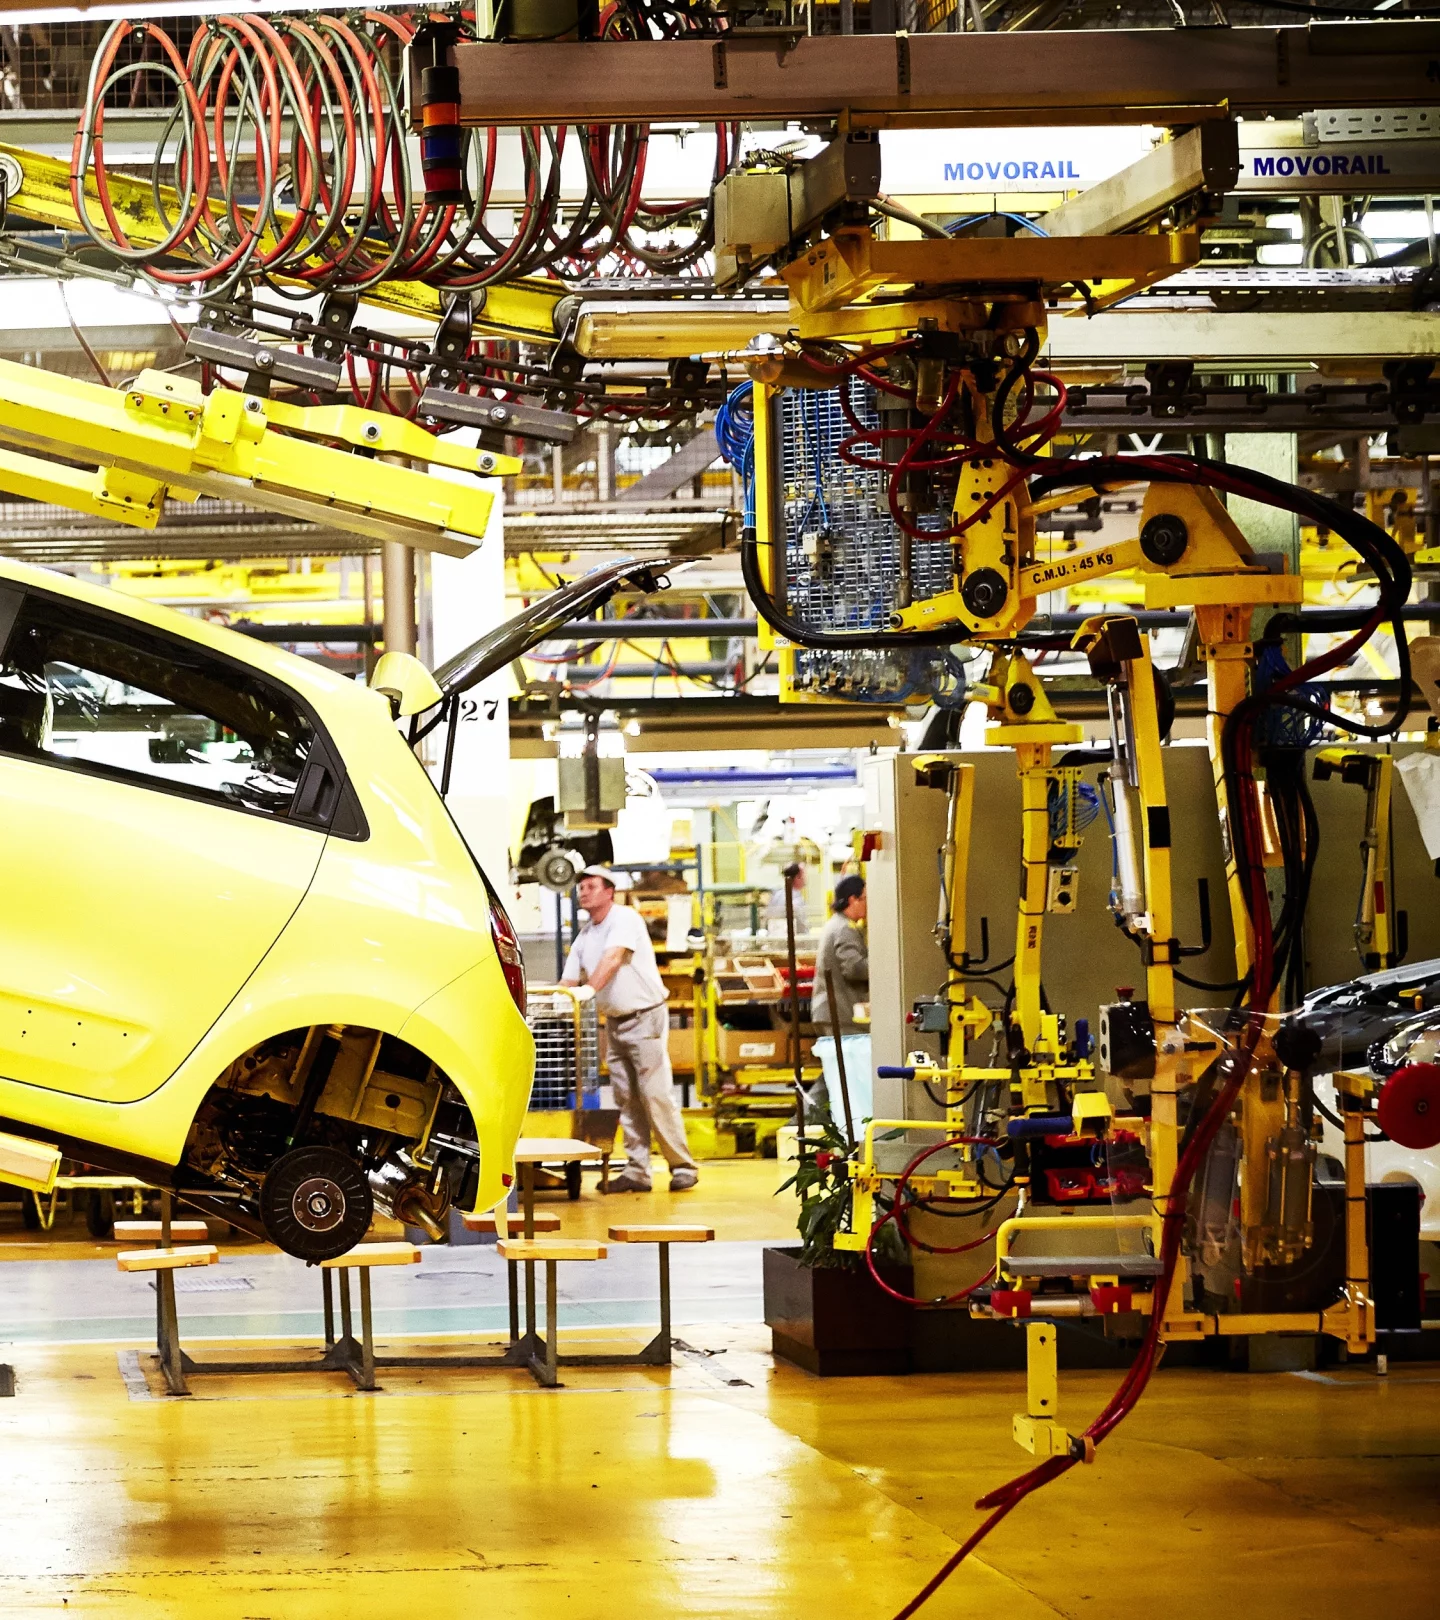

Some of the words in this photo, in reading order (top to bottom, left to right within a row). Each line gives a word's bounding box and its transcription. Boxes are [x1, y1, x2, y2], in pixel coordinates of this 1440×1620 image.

[943, 160, 1080, 182] MOVORAIL
[1252, 155, 1391, 178] MOVORAIL
[1033, 566, 1070, 584] C.M.U.
[1079, 557, 1094, 570] 45
[1097, 553, 1113, 565] Kg
